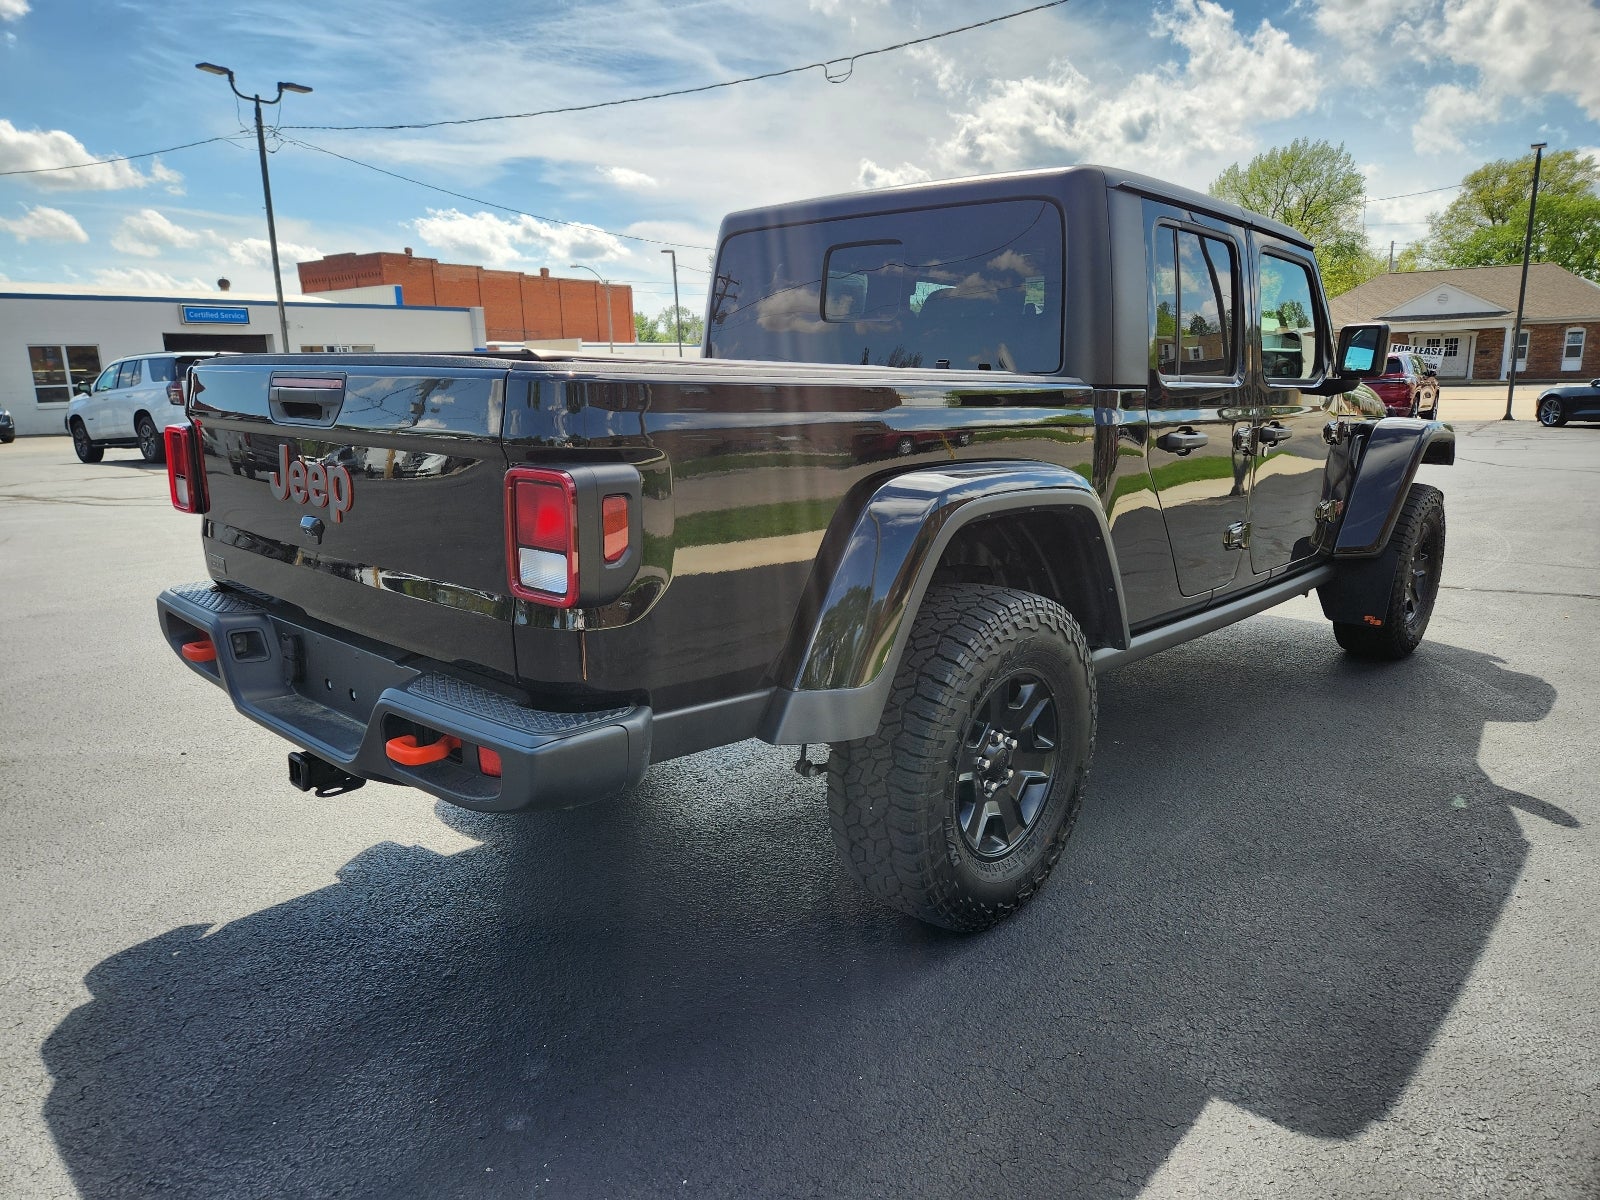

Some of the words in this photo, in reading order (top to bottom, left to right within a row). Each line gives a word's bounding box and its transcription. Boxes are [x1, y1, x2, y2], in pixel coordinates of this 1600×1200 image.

[189, 311, 219, 319] Certified
[1393, 344, 1412, 353] FOR
[1414, 346, 1443, 356] LEASE
[269, 444, 354, 523] Jeep
